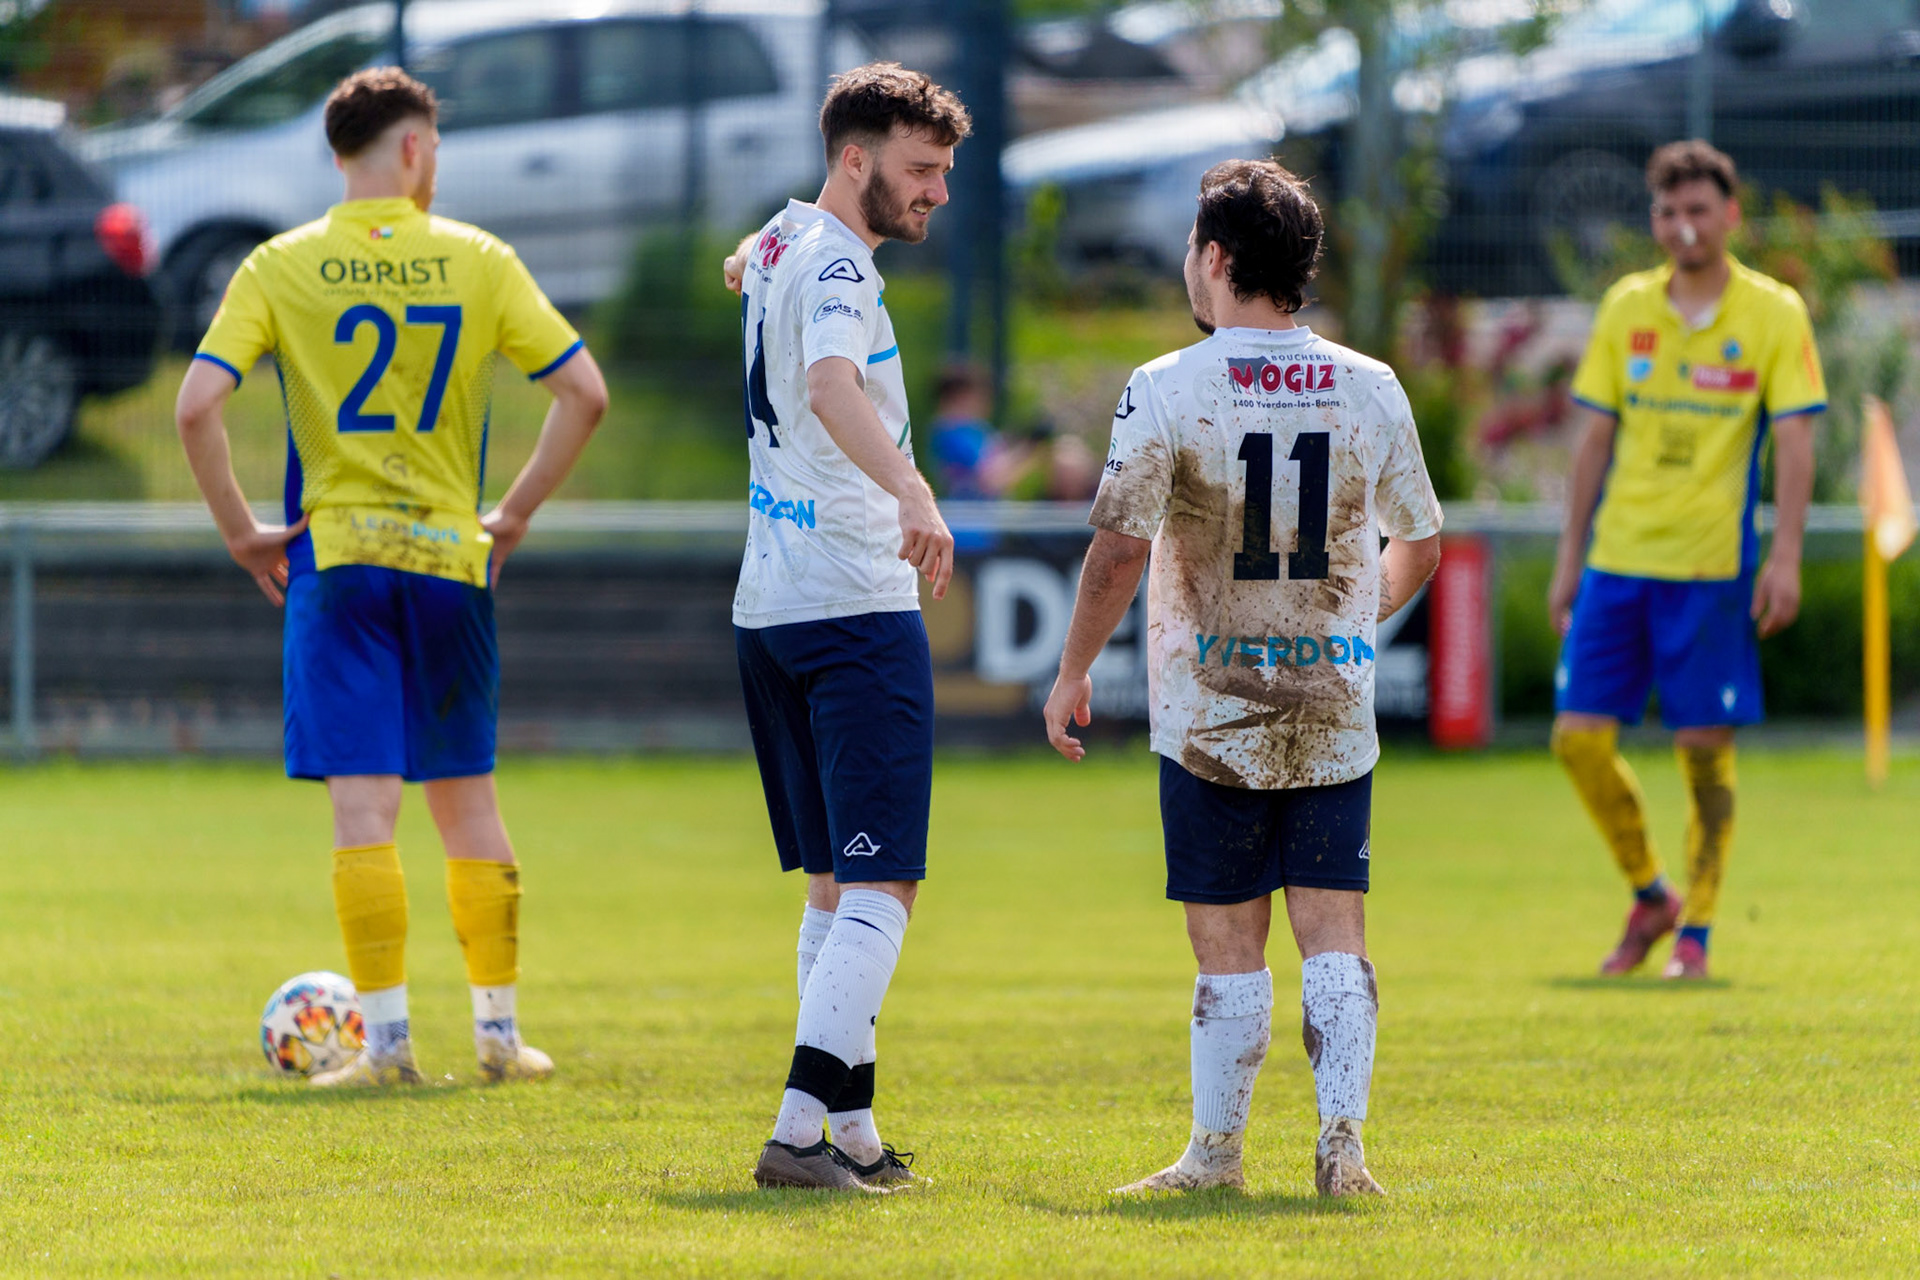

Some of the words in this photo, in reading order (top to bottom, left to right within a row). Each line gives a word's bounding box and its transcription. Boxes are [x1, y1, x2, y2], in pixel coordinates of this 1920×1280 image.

[320, 256, 451, 285] OBRIST
[822, 303, 852, 314] SMS
[333, 304, 463, 433] 27
[1271, 353, 1334, 362] BOUCHERIE
[1256, 398, 1341, 409] Yverdon-les-Bains
[1233, 431, 1331, 580] 11
[1196, 633, 1375, 668] YVERDON
